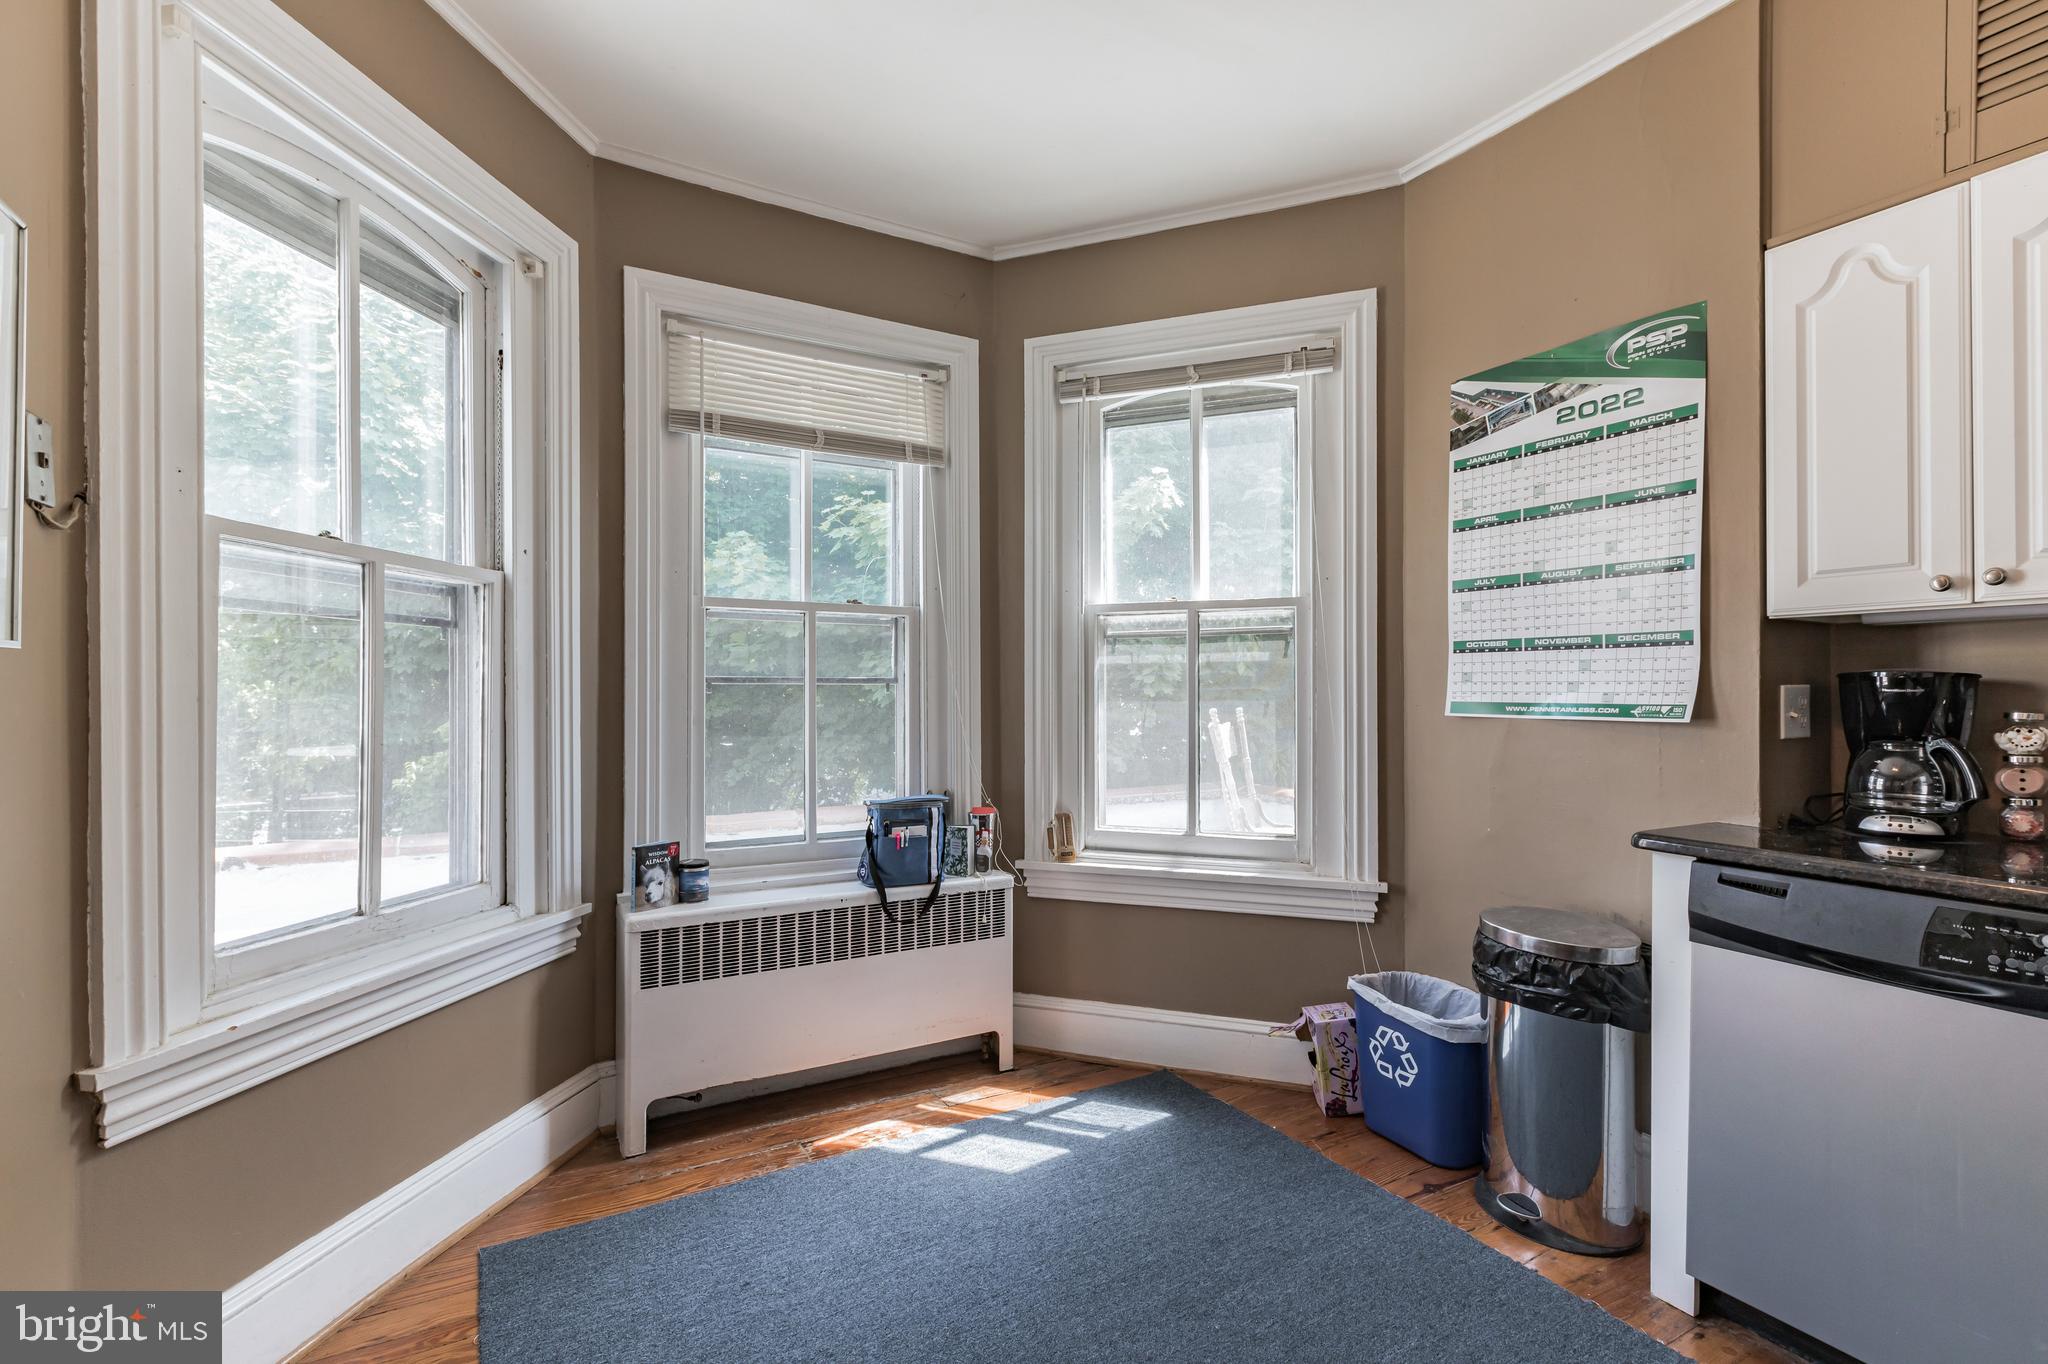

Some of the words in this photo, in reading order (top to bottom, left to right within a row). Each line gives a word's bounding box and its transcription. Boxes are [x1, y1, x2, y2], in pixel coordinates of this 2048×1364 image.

[1627, 323, 1688, 354] PSP
[1556, 386, 1645, 425] 2022
[1629, 411, 1673, 428] MARCH
[1535, 429, 1591, 449] FEBRUARY
[1466, 449, 1509, 466] JANUARY
[1634, 486, 1666, 498] JUNE
[1549, 501, 1574, 512] MAY
[1473, 515, 1500, 525] APRIL
[1615, 556, 1685, 571] SEPTEMBER
[1540, 568, 1584, 579] AUGUST
[1474, 577, 1497, 586] JULY
[1534, 636, 1592, 646] NOVEMBER
[1617, 632, 1680, 642] DECEMBER
[1466, 640, 1509, 648] OCTOBER
[645, 856, 672, 866] ALPACAS
